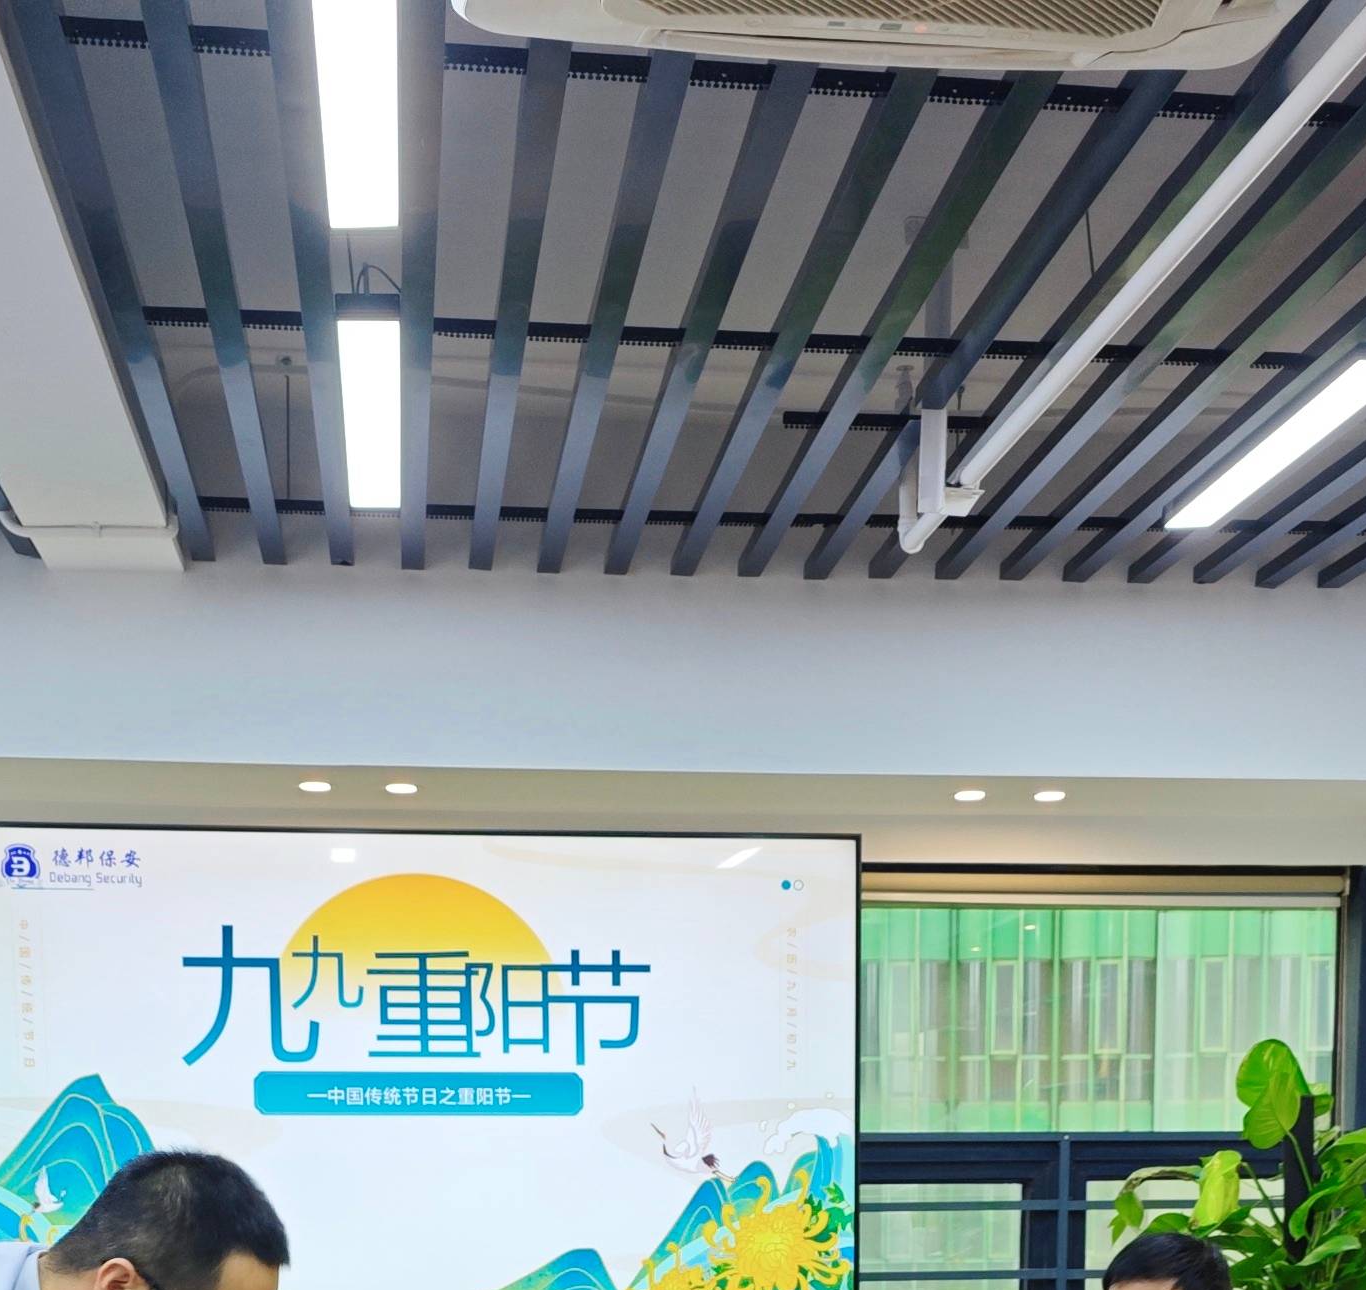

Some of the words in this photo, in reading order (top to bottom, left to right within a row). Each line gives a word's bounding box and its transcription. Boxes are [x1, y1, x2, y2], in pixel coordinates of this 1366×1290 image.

[52, 847, 142, 868] 德邦保安
[49, 871, 92, 887] Debang
[96, 872, 143, 888] Security
[181, 924, 651, 1067] 九九重阳节
